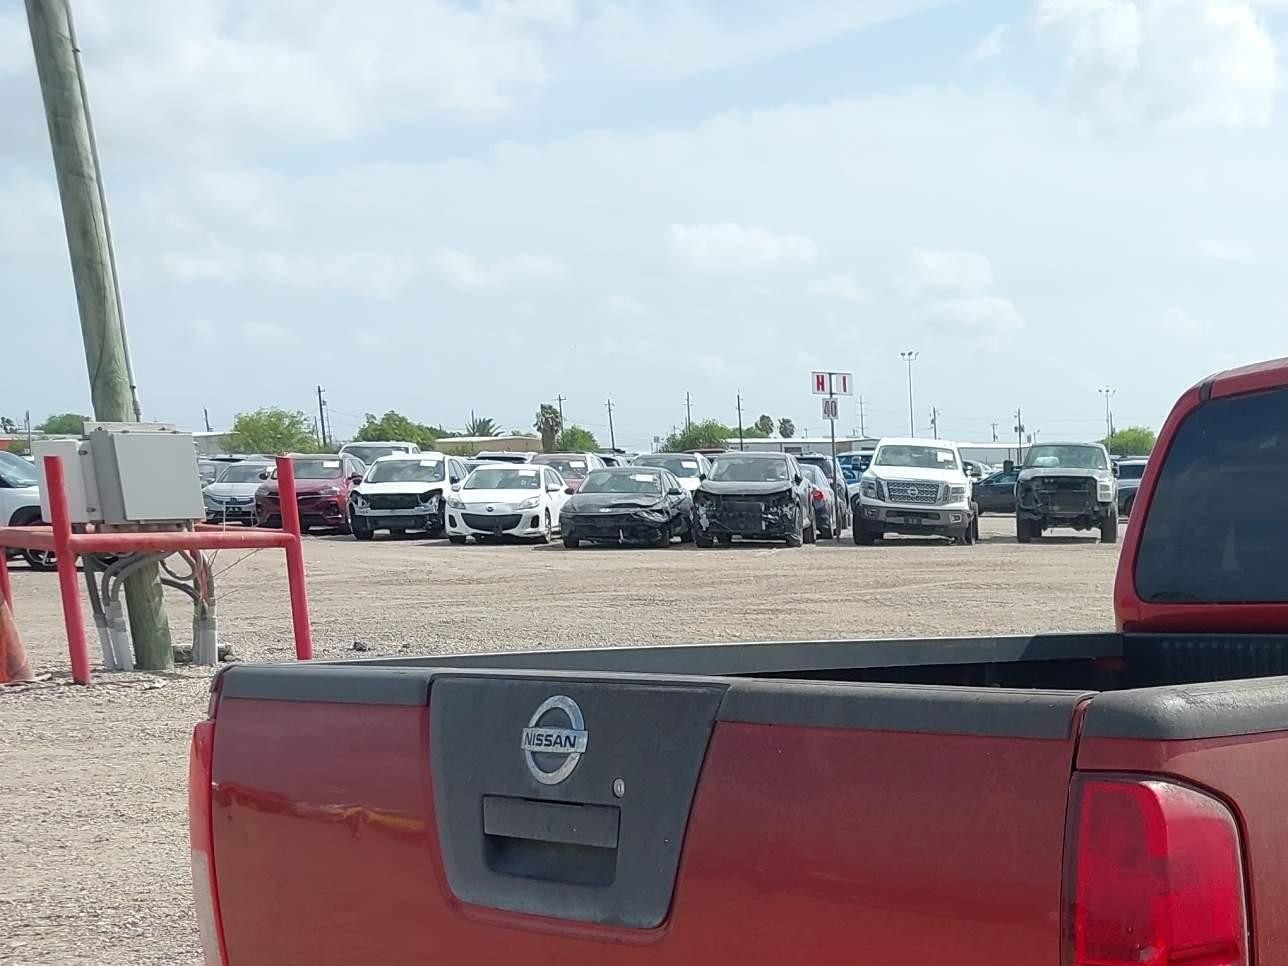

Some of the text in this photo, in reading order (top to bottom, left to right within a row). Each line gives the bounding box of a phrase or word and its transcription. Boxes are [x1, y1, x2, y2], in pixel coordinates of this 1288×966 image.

[816, 374, 825, 392] H
[824, 400, 837, 418] 40
[524, 731, 577, 749] NISSAN
